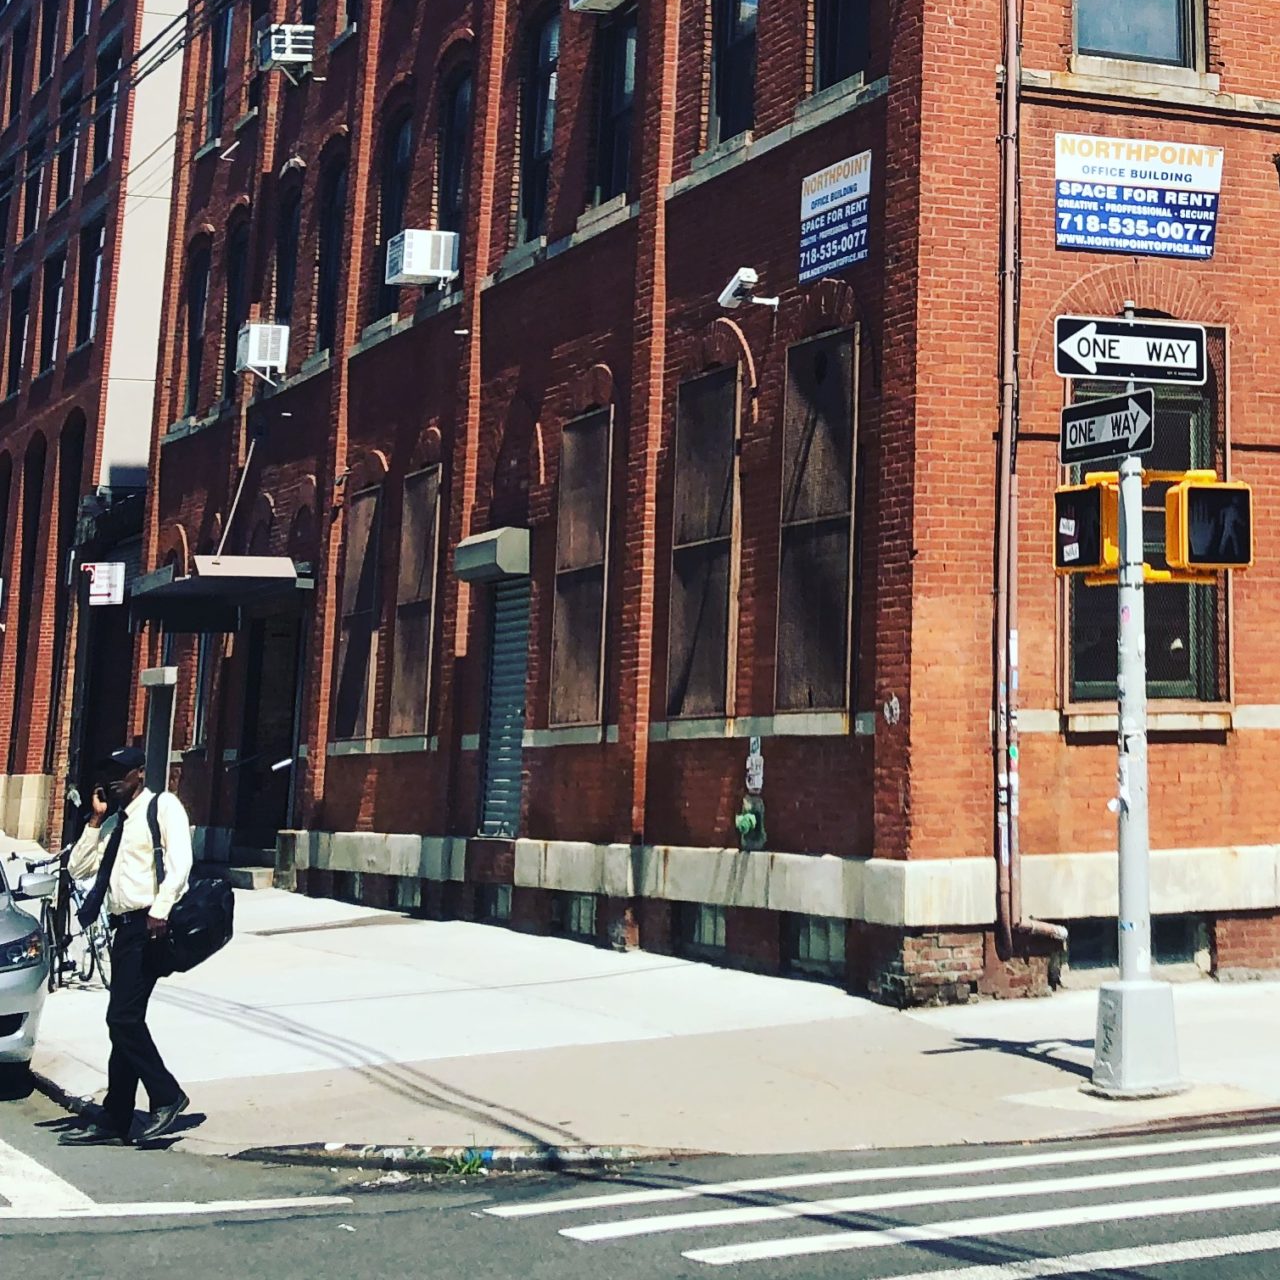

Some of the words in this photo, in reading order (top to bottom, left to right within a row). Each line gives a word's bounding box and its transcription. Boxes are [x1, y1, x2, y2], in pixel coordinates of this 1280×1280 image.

[1060, 138, 1219, 168] NORTHPOINT
[803, 153, 870, 197] NORTHPOINT
[1082, 165, 1126, 178] OFFICE
[1130, 169, 1193, 183] BUILDING
[810, 194, 830, 210] OFFICE
[830, 183, 858, 204] BUILDING
[1059, 181, 1117, 200] SPACE
[1123, 187, 1159, 204] FOR
[1165, 192, 1215, 207] RENT
[801, 215, 825, 235] SPACE
[827, 208, 843, 225] FOR
[845, 198, 867, 216] RENT
[1057, 199, 1098, 211] CREATIVE
[1179, 209, 1215, 220] SECURE
[1058, 213, 1212, 241] 718-535-0077
[800, 228, 867, 268] 718-535-0077
[1057, 233, 1213, 256] WWW.NORTHPOINTOFFICE.NET
[1077, 336, 1121, 360] ONE
[1146, 341, 1191, 364] WAY
[1069, 419, 1096, 446] ONE
[1110, 410, 1140, 438] WAY
